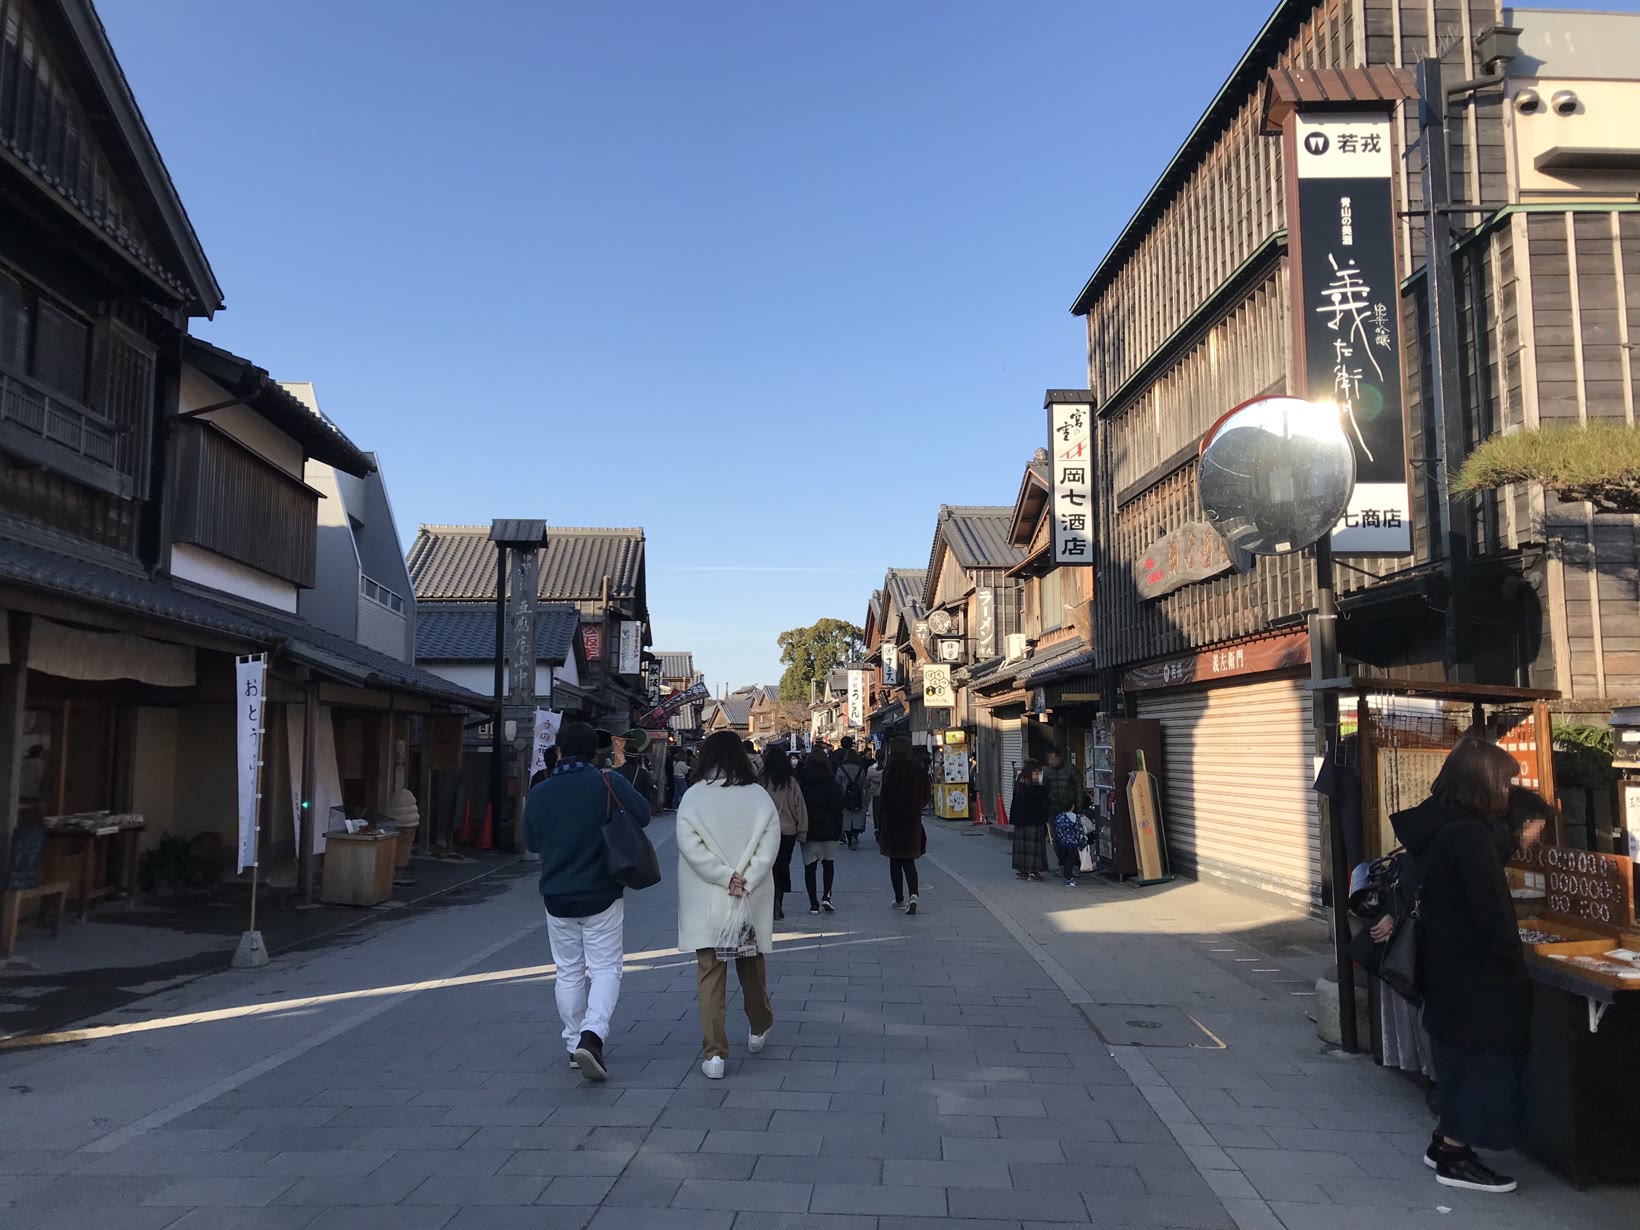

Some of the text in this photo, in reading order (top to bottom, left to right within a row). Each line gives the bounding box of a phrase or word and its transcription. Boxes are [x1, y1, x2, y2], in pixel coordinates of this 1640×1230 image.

[1337, 133, 1382, 153] 若戎
[1060, 467, 1087, 556] 岡七酒店
[1334, 508, 1402, 529] 七商店
[978, 590, 993, 645] ラーメン
